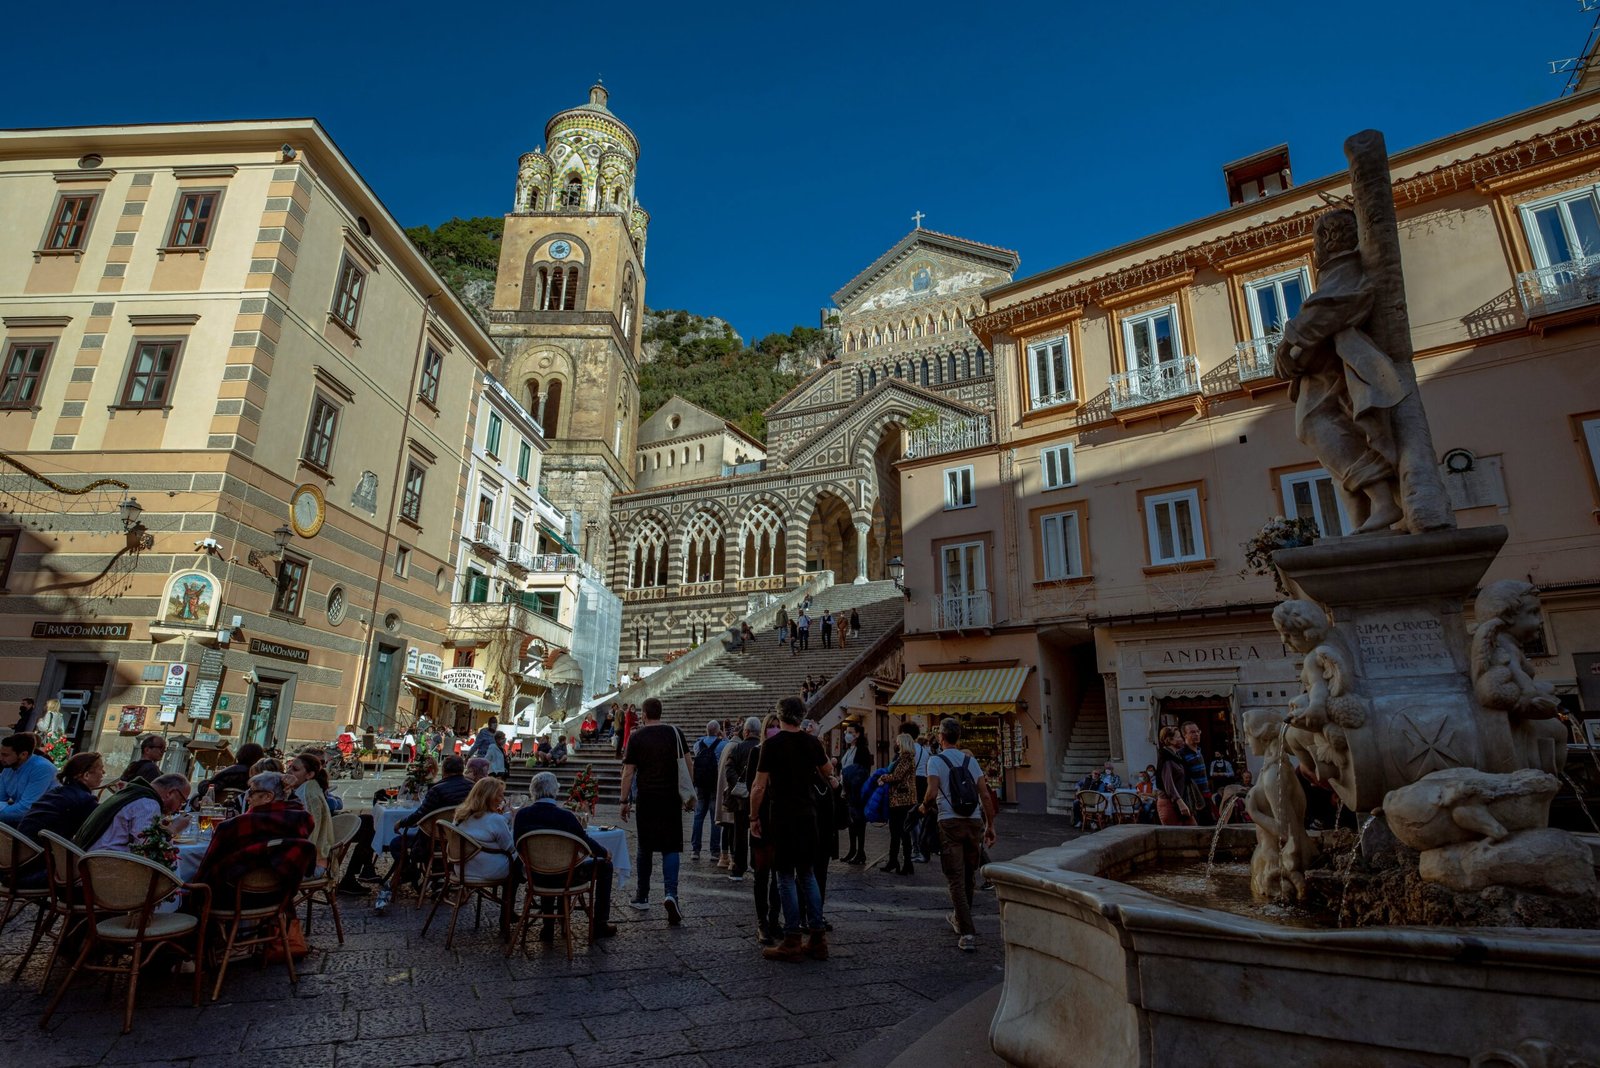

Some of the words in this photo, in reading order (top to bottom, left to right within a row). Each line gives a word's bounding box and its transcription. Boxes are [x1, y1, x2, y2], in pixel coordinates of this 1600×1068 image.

[47, 625, 82, 636] BANCO
[90, 625, 127, 636] NAPOLI
[260, 642, 282, 655] BANCO
[1163, 645, 1261, 664] ANDREA
[420, 657, 441, 666] RISTORANTE
[443, 672, 483, 680] RISTORANTE
